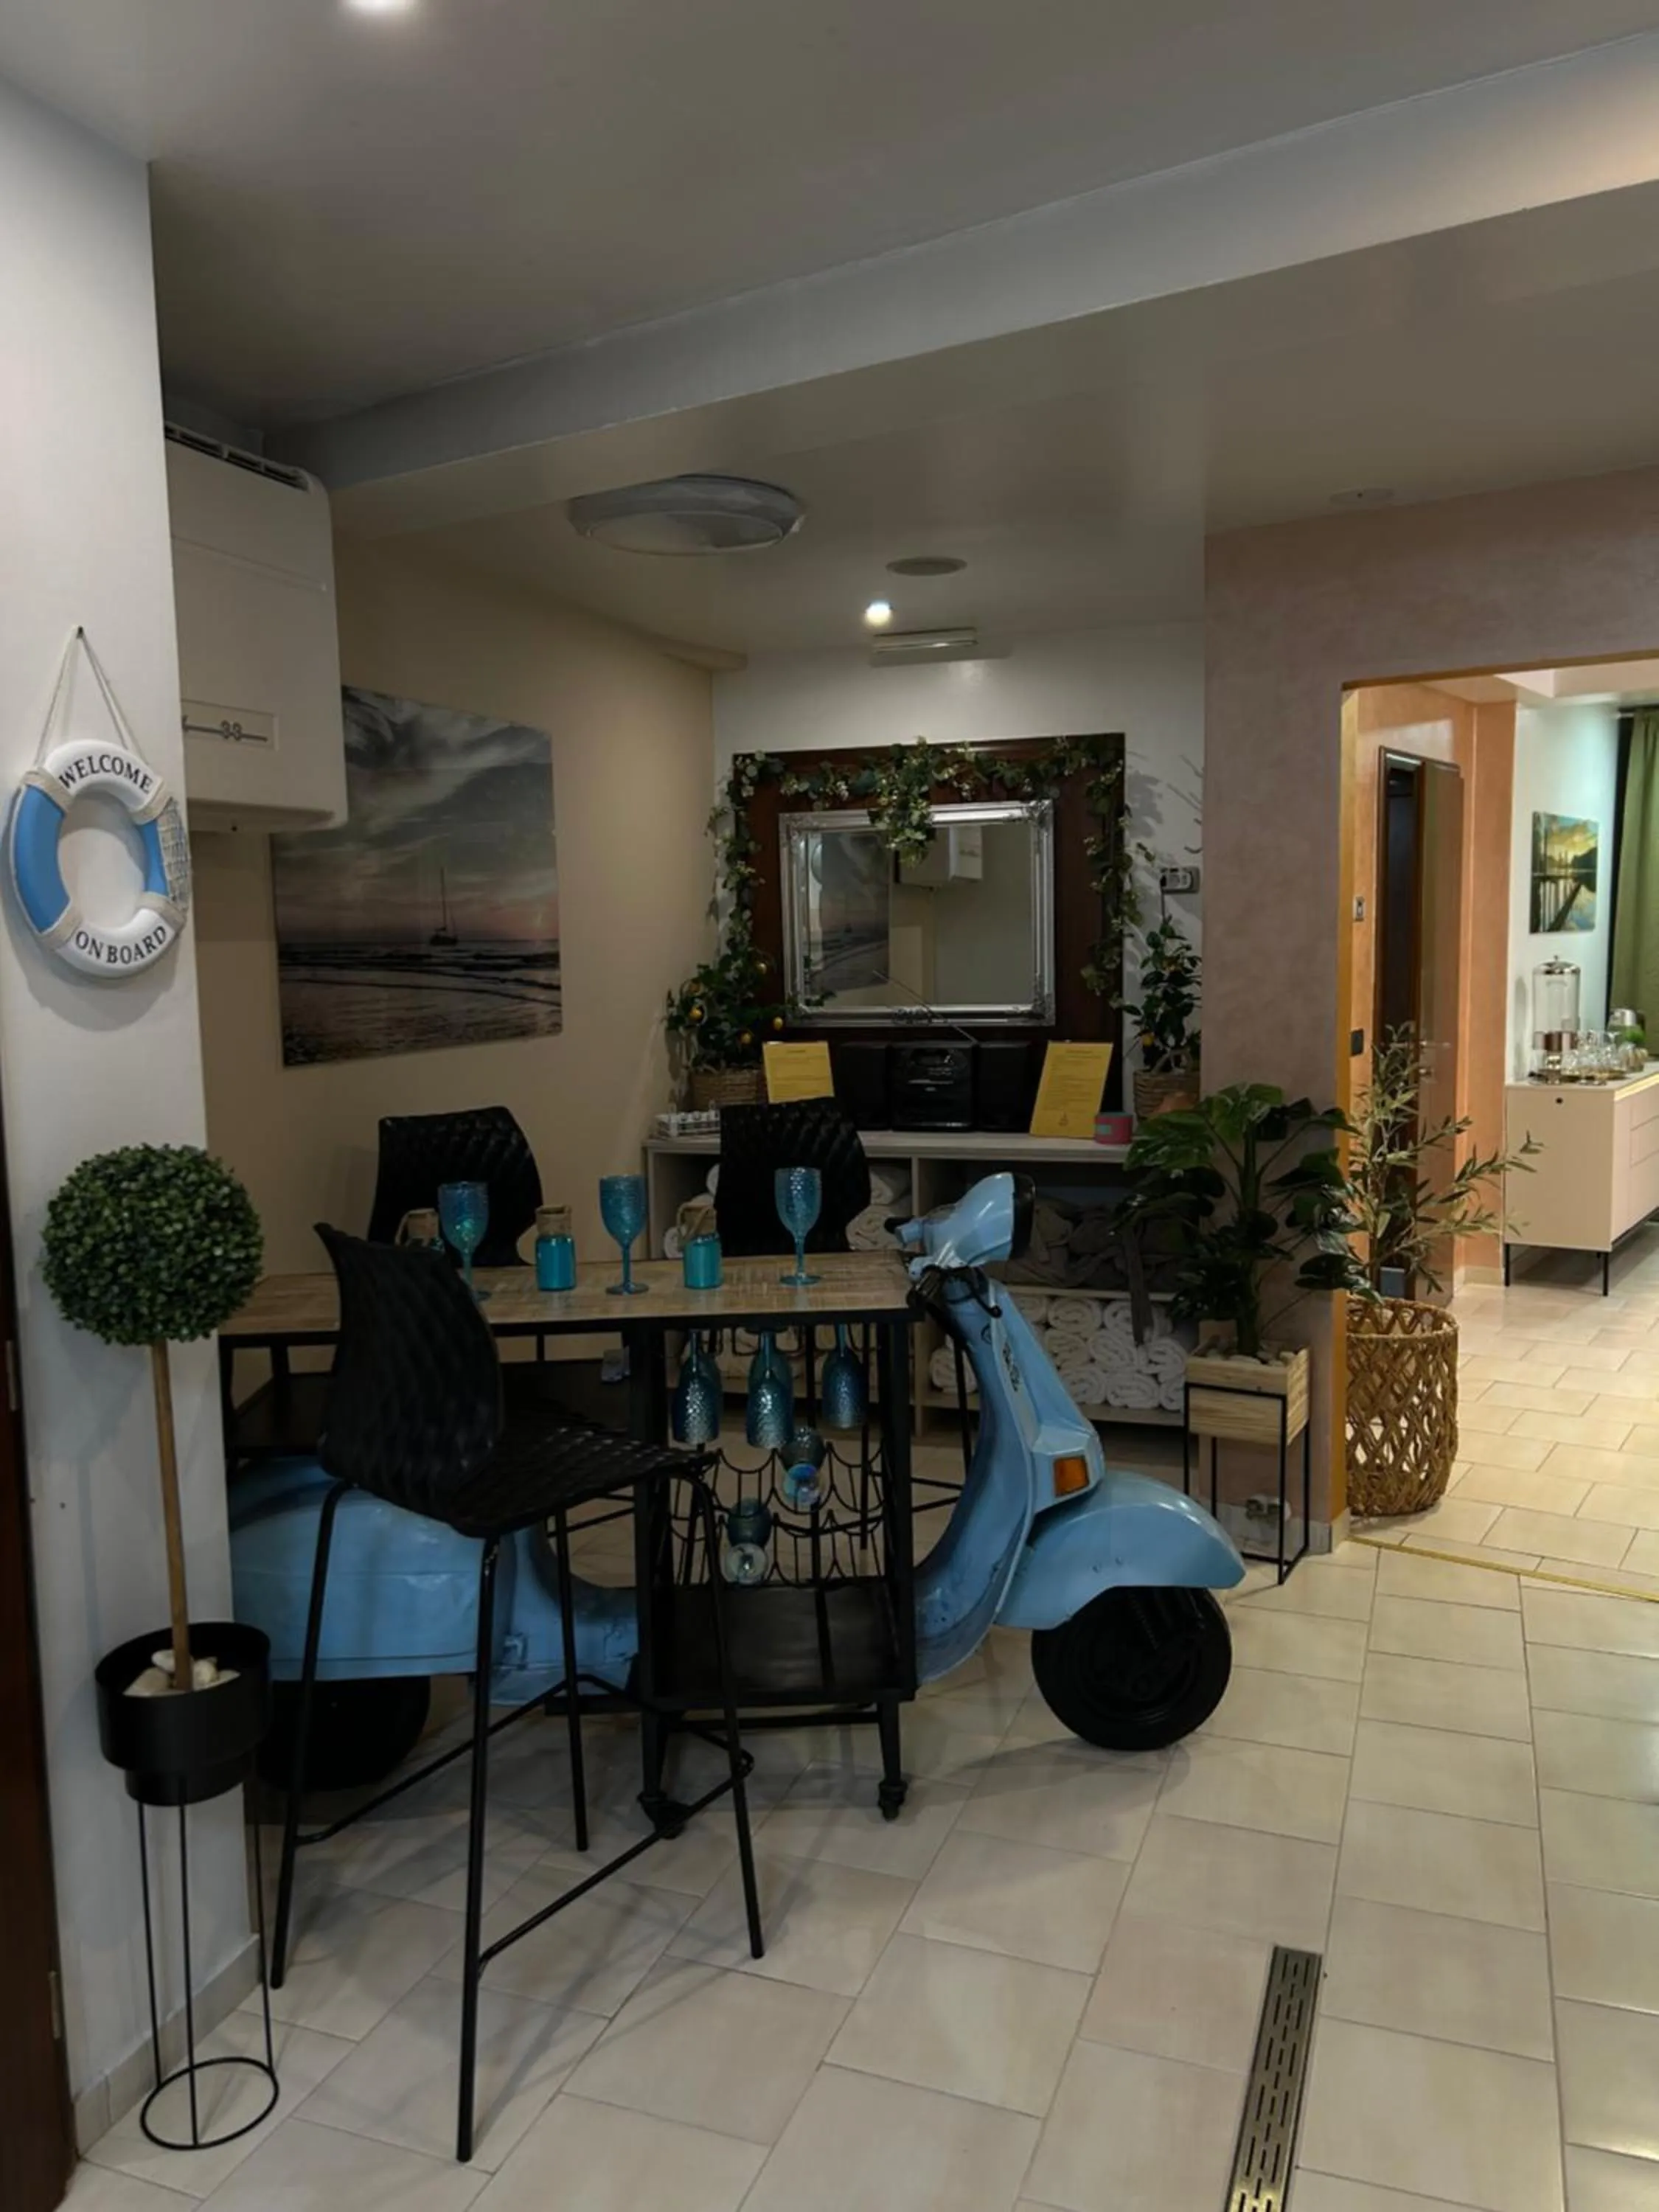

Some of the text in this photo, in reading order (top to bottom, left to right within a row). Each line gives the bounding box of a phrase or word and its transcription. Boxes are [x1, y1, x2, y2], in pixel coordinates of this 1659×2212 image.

[58, 754, 153, 793] WELCOME
[75, 925, 167, 964] ON BOARD
